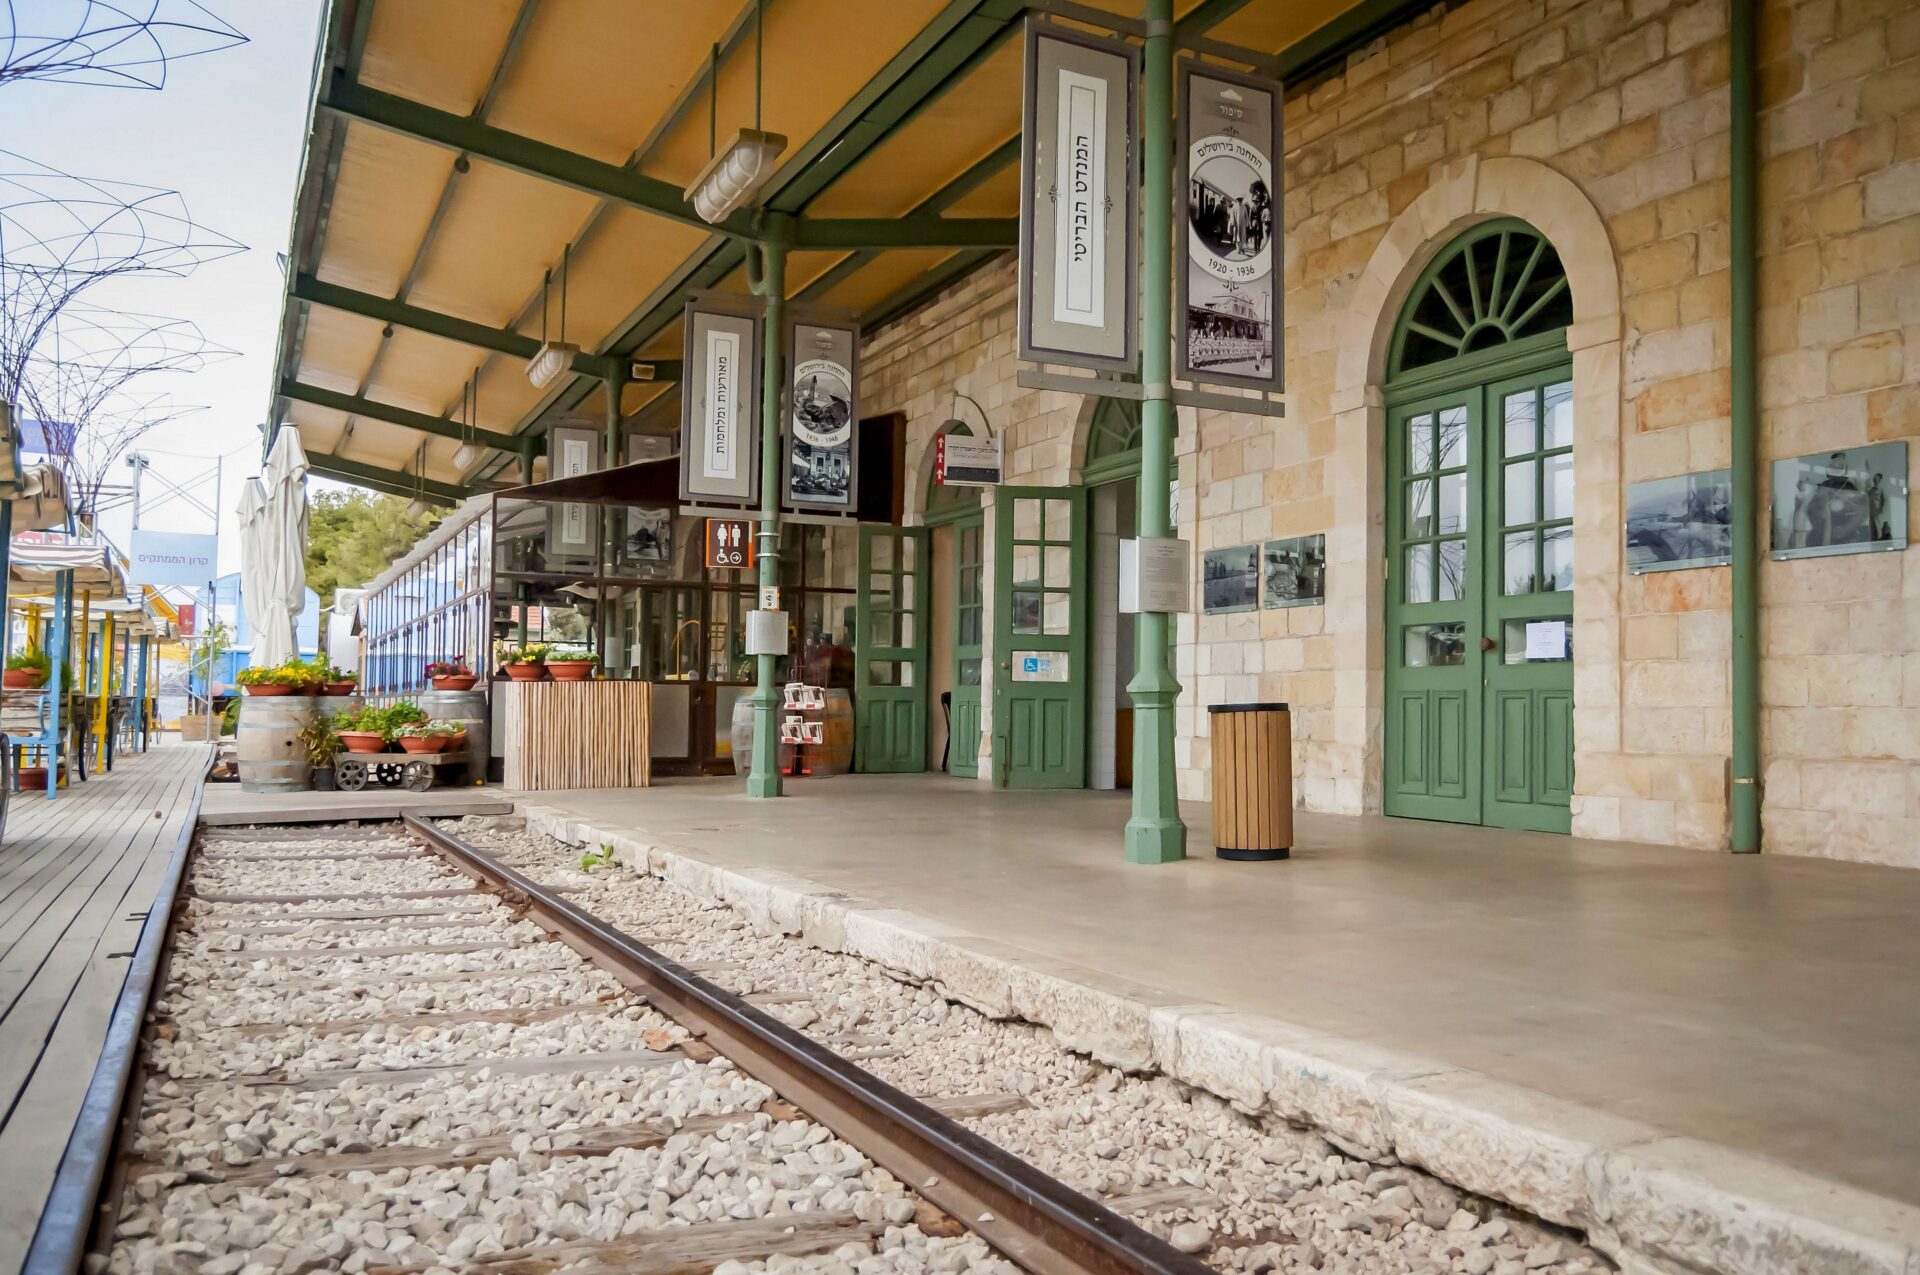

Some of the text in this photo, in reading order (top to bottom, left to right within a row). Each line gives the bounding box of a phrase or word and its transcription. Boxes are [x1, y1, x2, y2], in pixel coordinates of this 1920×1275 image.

[1220, 105, 1243, 119] סיפור
[1197, 142, 1262, 169] התחנה בירושלים
[1074, 135, 1089, 262] המנדט הבריטי
[1208, 258, 1227, 274] 1920
[1236, 264, 1255, 276] 1936
[715, 356, 727, 454] מאורעות ומלחמות
[138, 554, 209, 567] קרון הממתקים
